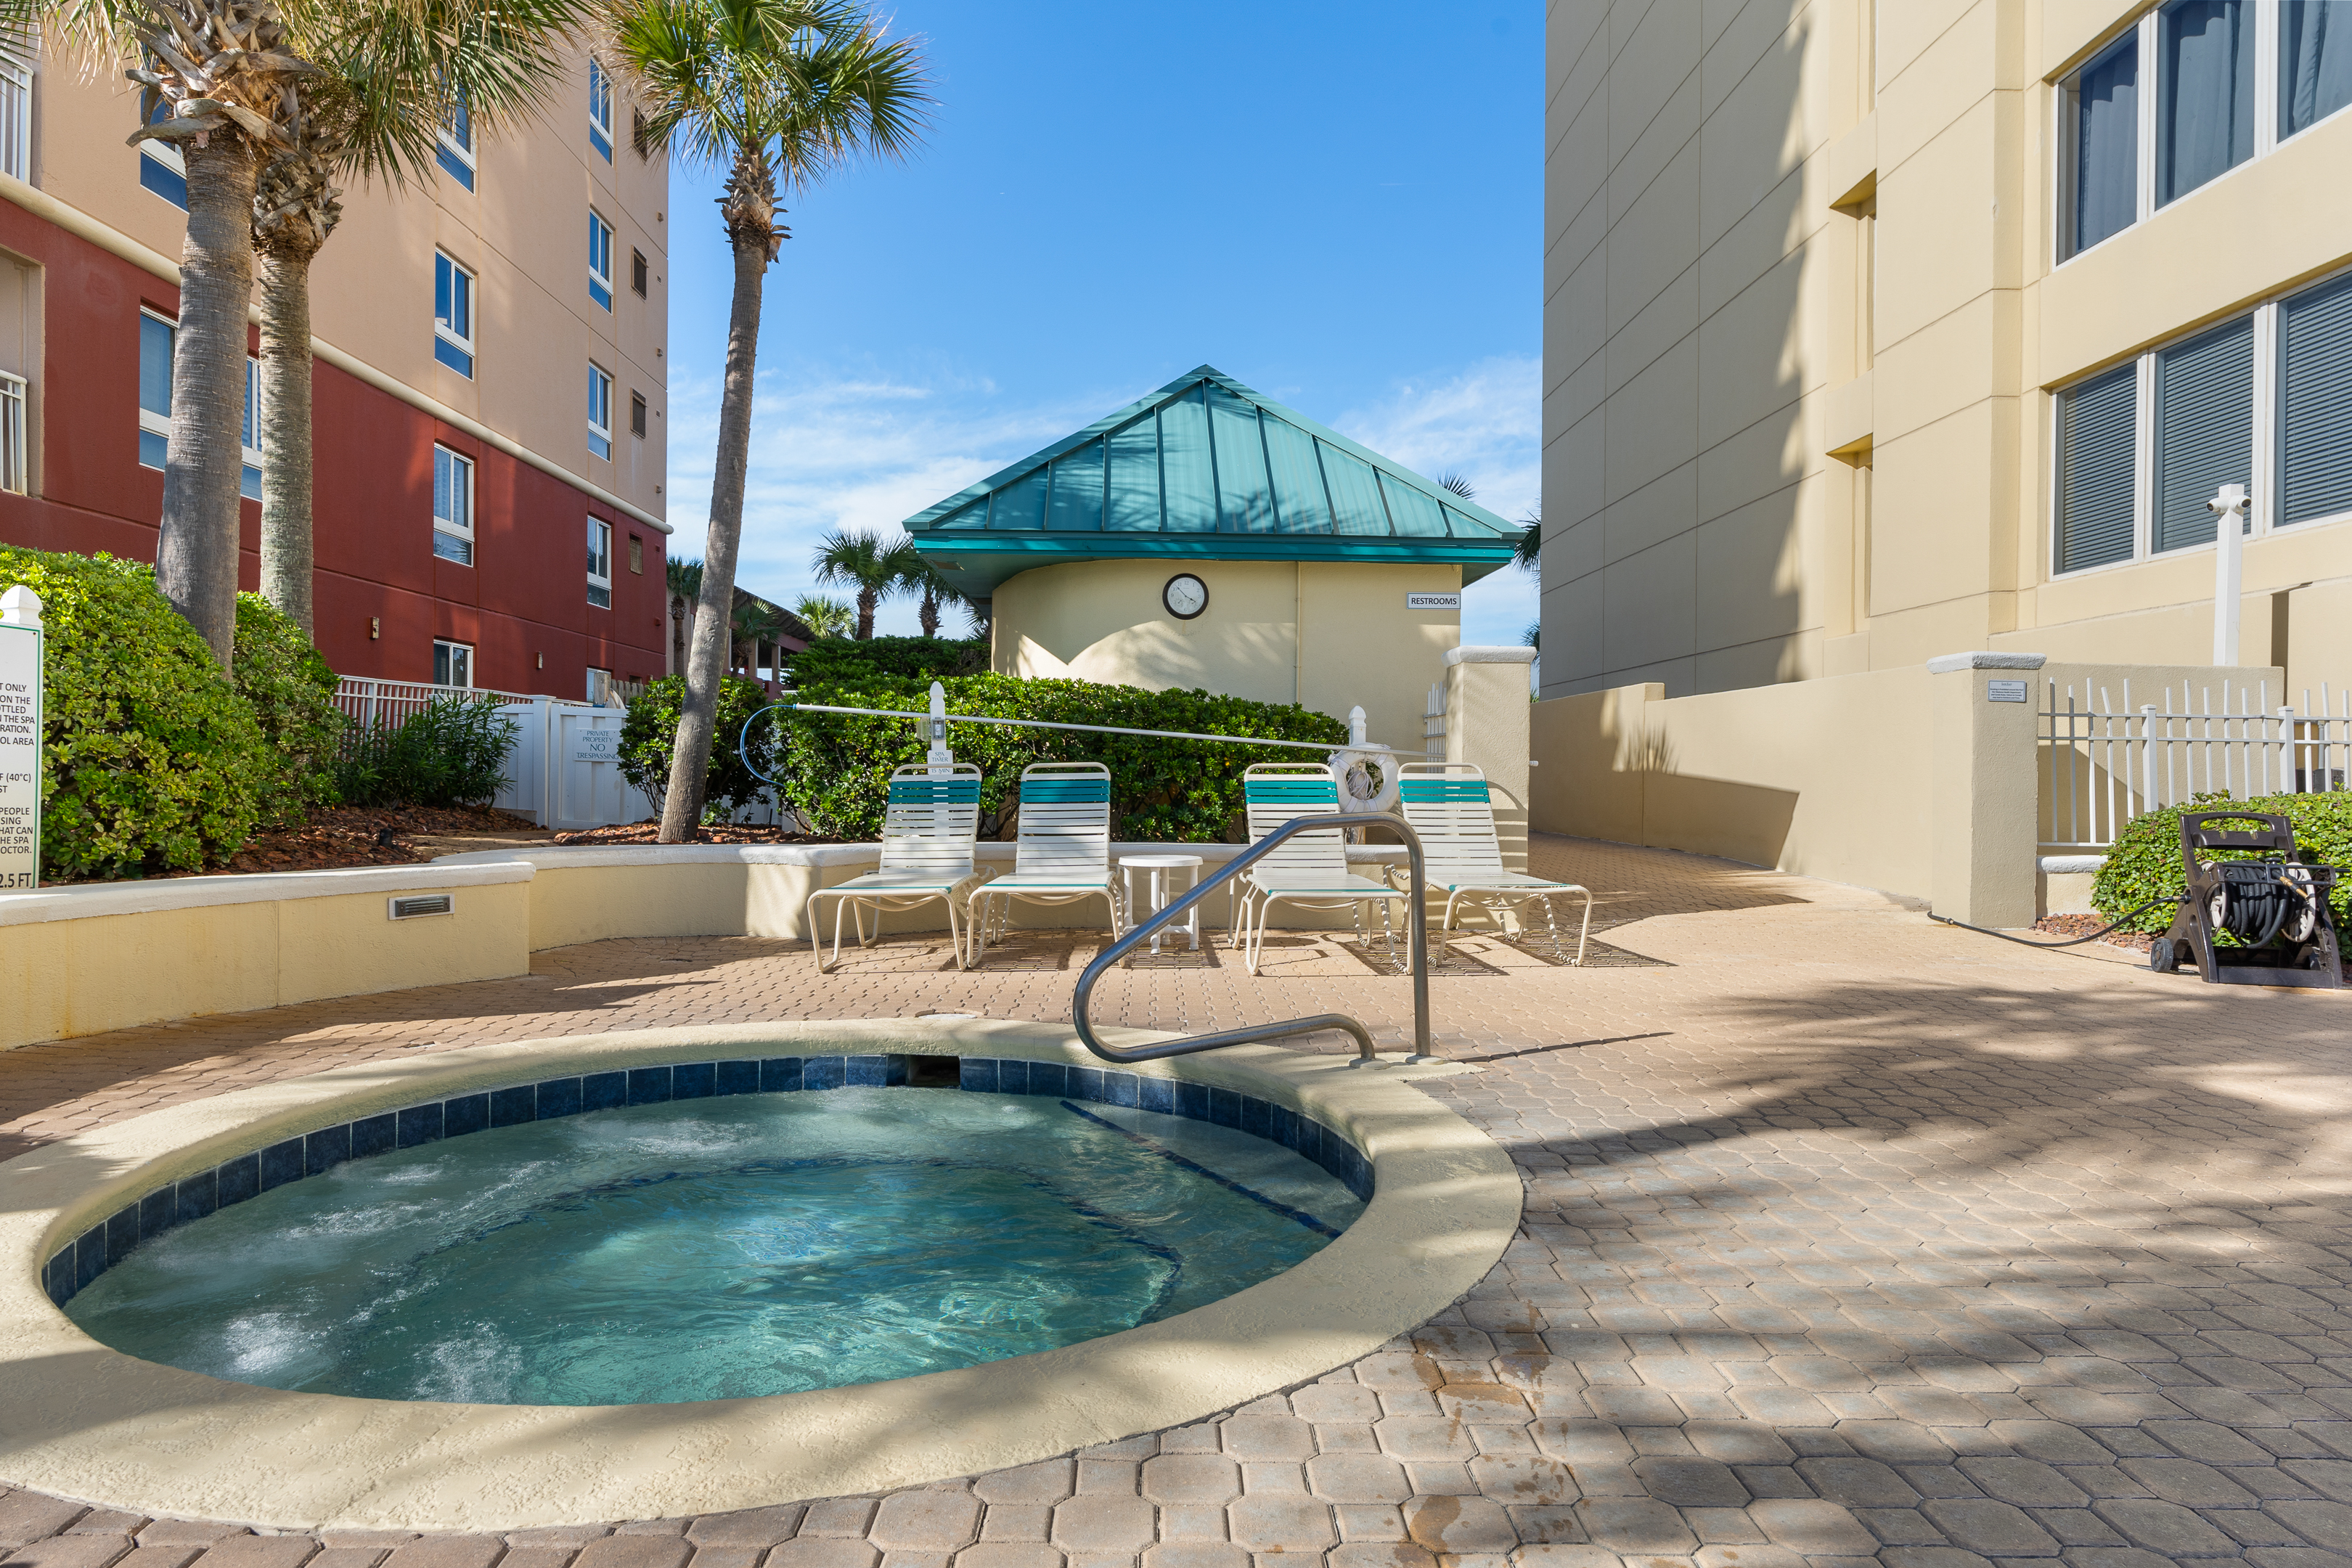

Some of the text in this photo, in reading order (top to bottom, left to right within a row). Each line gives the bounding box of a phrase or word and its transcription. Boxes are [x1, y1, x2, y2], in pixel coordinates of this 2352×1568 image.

[5, 683, 27, 693] ONLY
[0, 695, 30, 705] ON THE
[0, 705, 26, 714] TTLED
[4, 714, 19, 723] THE
[20, 716, 35, 724] SPA
[12, 737, 34, 746] AREA
[6, 772, 31, 783] (40°C)
[16, 826, 33, 835] CAN
[18, 873, 32, 887] FT
